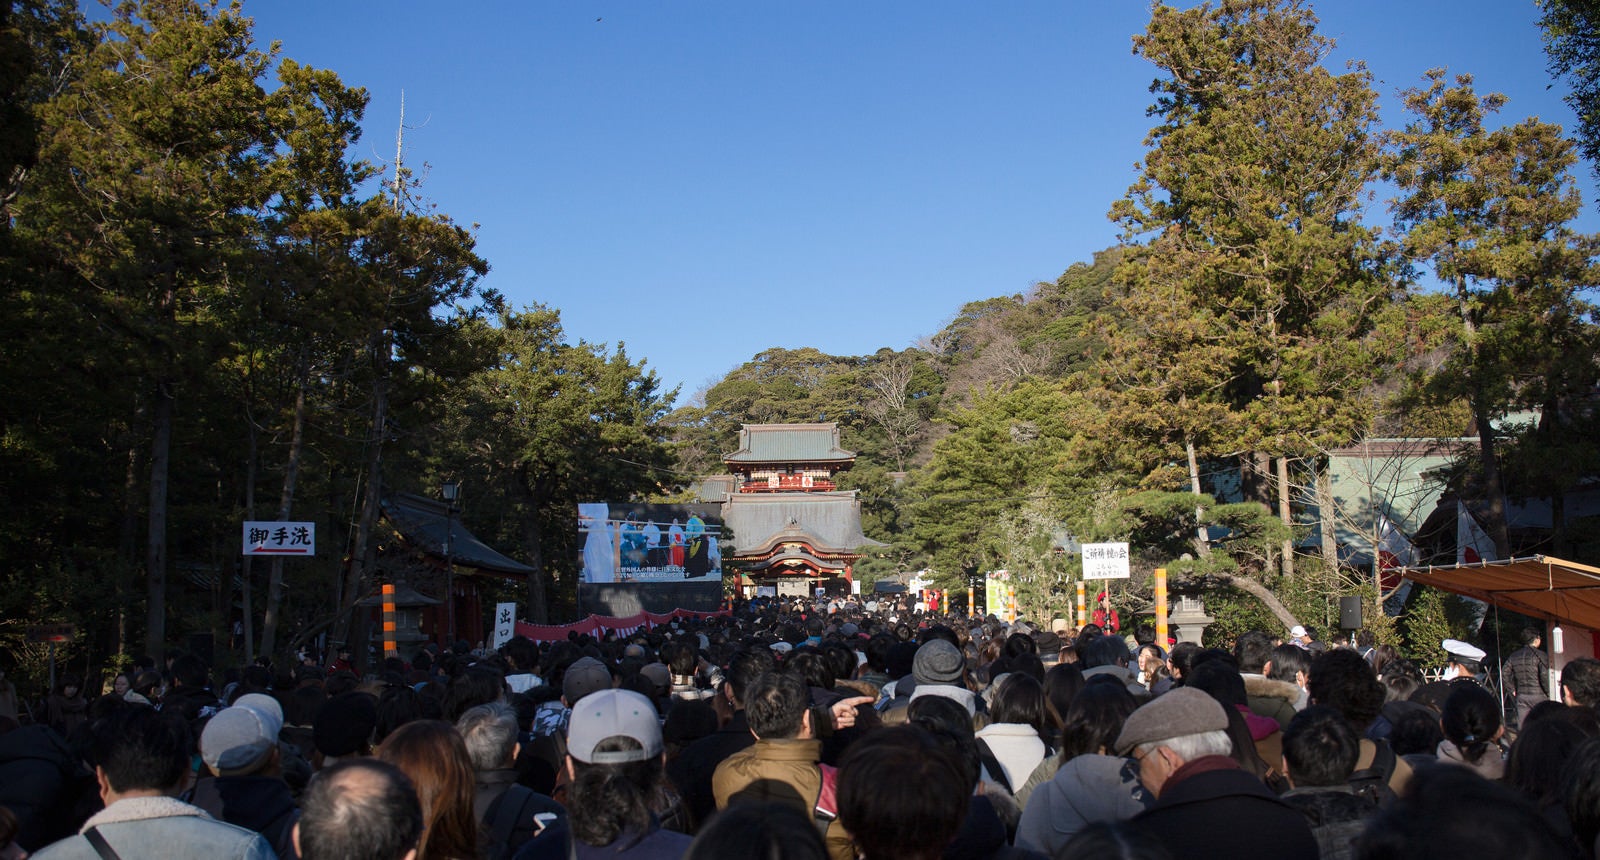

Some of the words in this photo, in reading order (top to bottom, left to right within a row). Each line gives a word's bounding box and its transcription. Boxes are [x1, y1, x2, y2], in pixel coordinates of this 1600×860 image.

[249, 526, 311, 546] 御手洗
[499, 608, 511, 637] 出口
